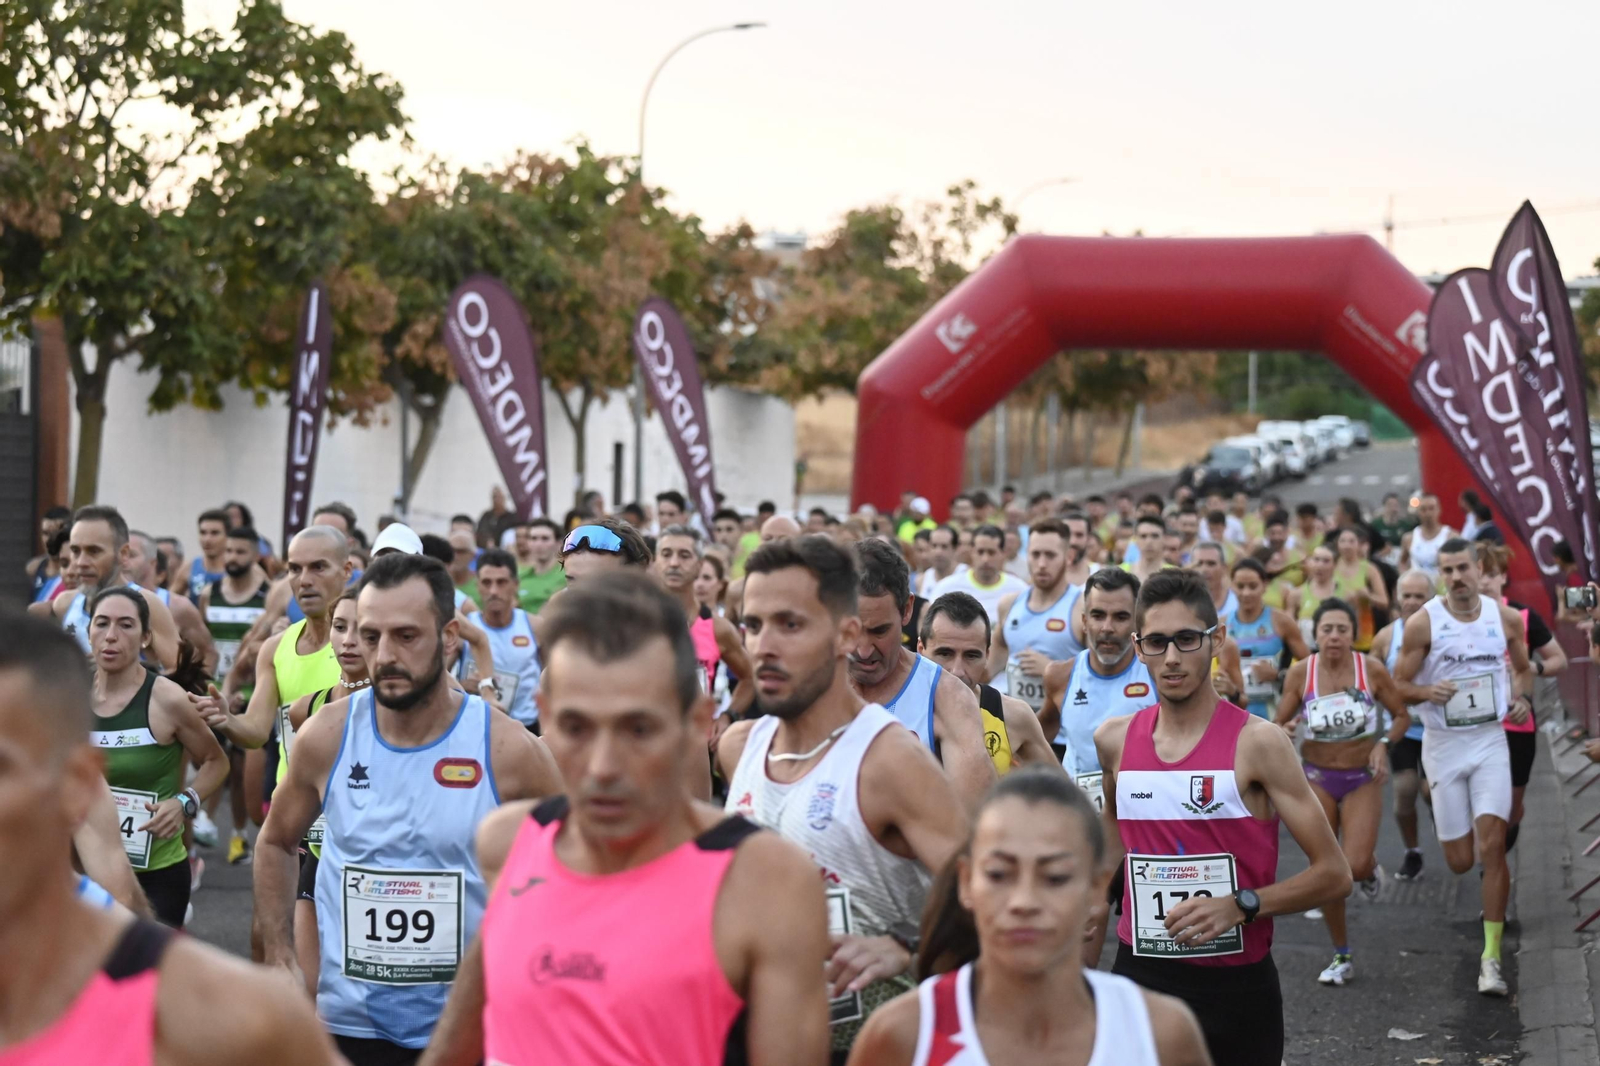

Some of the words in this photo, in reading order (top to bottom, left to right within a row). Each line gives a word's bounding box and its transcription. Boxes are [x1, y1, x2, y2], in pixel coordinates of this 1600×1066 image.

[1466, 693, 1477, 709] 1
[1321, 709, 1356, 728] 168
[120, 816, 134, 838] 4
[372, 880, 423, 888] FESTIVAL
[365, 907, 436, 944] 199
[377, 965, 392, 978] 5k
